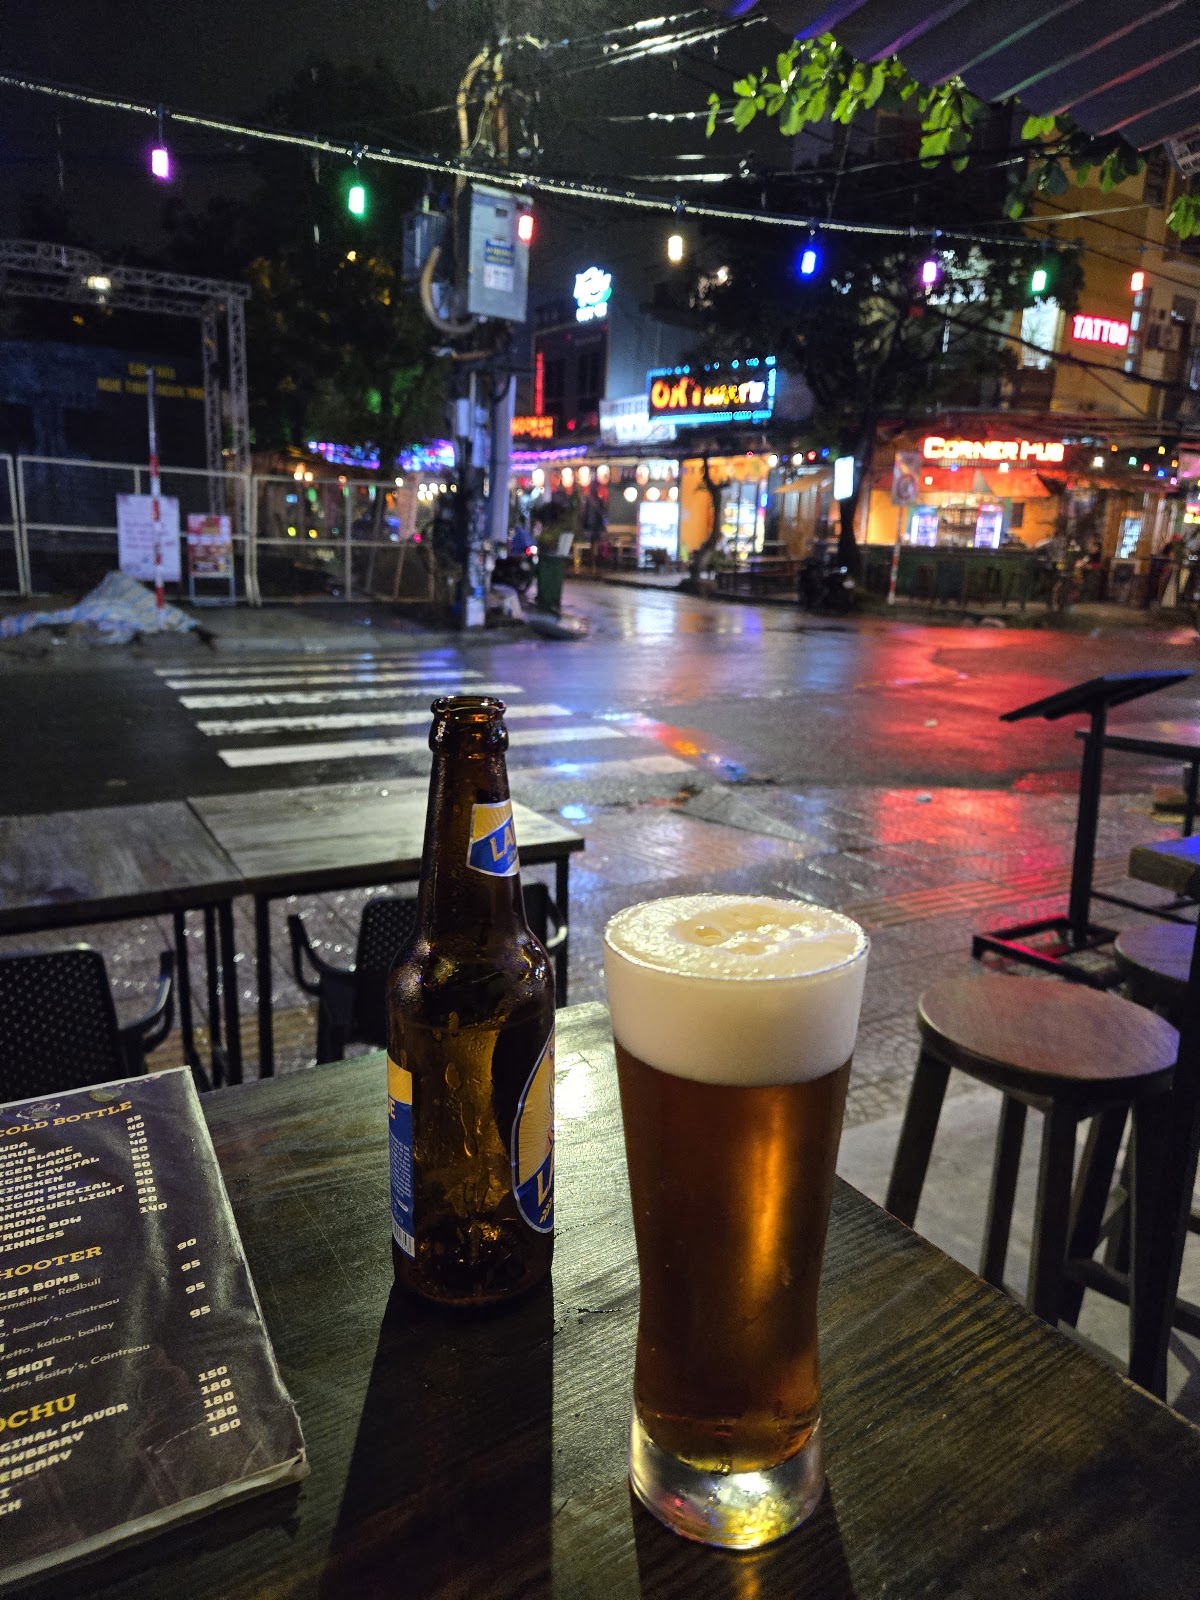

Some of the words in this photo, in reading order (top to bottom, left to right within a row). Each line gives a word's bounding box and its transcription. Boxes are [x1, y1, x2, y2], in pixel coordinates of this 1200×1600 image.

[1073, 314, 1129, 346] TATTOO
[923, 437, 1019, 460] CORNER
[53, 1101, 132, 1126] BOTTLE
[127, 1122, 144, 1130] 40
[128, 1130, 145, 1138] 70
[27, 1146, 73, 1163] BLANC
[36, 1152, 82, 1170] LAGER
[36, 1157, 100, 1178] CRYSTAL
[47, 1181, 77, 1192] RED
[47, 1181, 111, 1200] SPECIAL
[78, 1184, 125, 1202] LIGHT
[140, 1203, 167, 1213] 140
[0, 1225, 45, 1241] RONG
[49, 1216, 81, 1229] BOW
[177, 1238, 196, 1250] 90
[0, 1246, 103, 1280] HOOTER
[181, 1259, 200, 1272] 95
[33, 1273, 80, 1292] BOMB
[58, 1277, 101, 1296] Redbull
[185, 1282, 205, 1294] 95
[65, 1298, 120, 1318] cointreau
[190, 1305, 211, 1318] 95
[78, 1322, 115, 1338] bailey
[90, 1344, 150, 1365] Cointreau
[6, 1356, 55, 1380] SHOT
[198, 1366, 227, 1382] 150
[201, 1378, 231, 1395] 180
[203, 1391, 234, 1408] 180
[61, 1403, 128, 1432] FLAVOR
[206, 1405, 238, 1422] 180
[209, 1418, 241, 1437] 180
